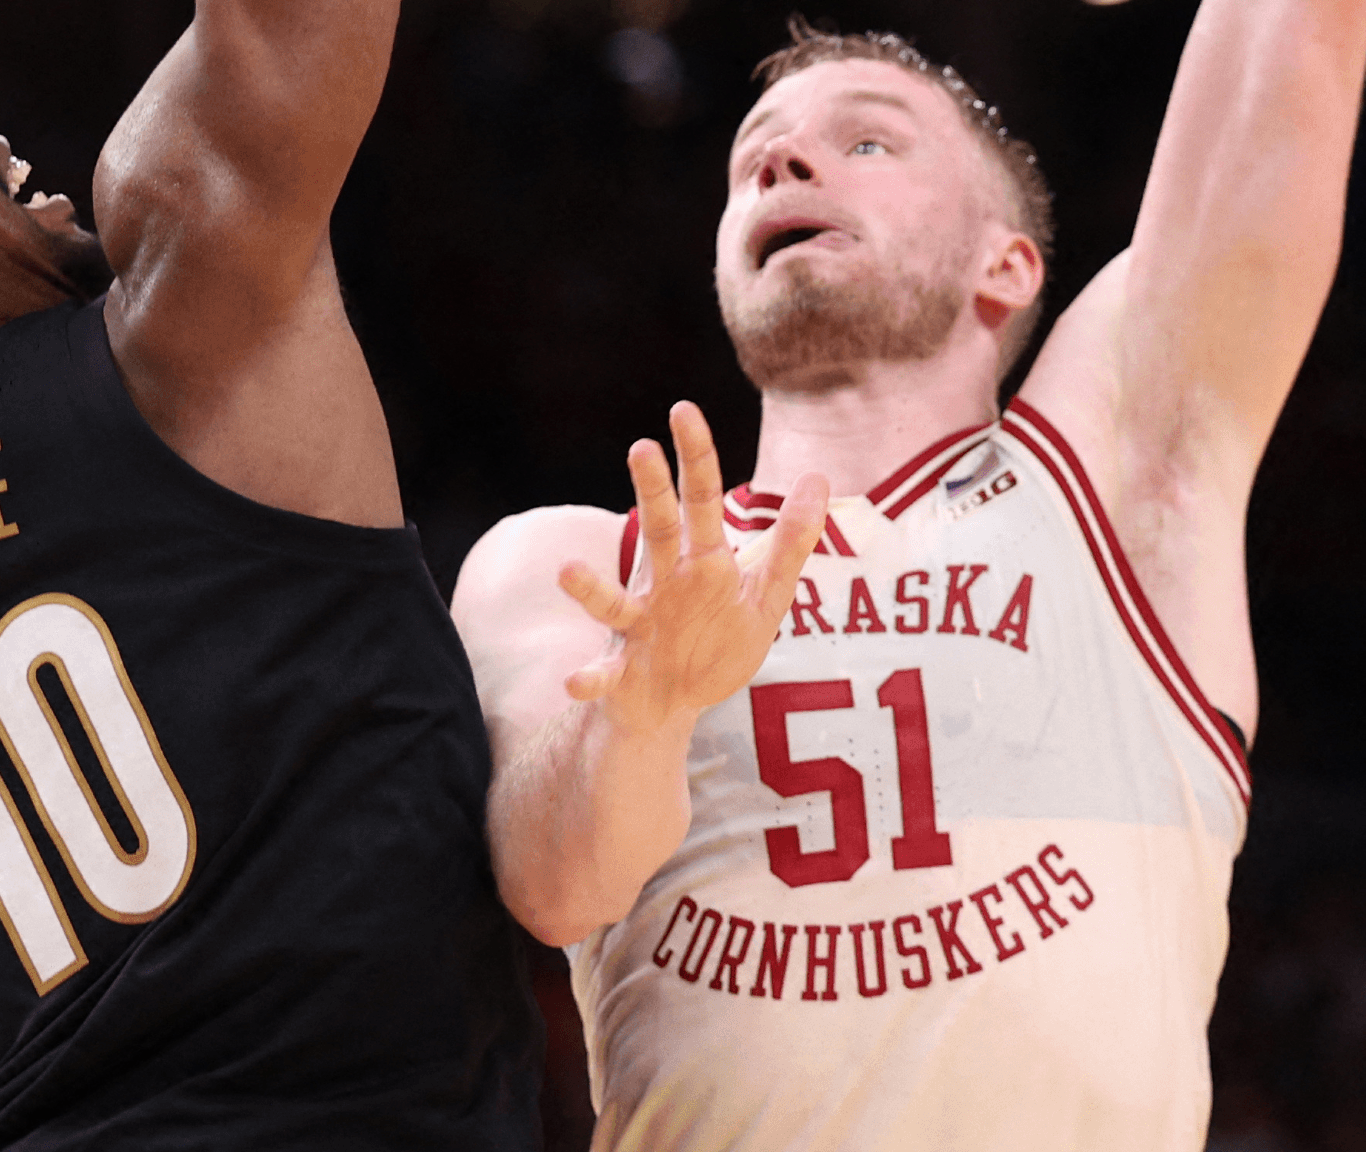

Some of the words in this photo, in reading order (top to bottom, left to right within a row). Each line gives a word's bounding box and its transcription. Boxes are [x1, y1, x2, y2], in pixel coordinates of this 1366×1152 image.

[774, 564, 1035, 652] RASKA
[749, 667, 954, 888] 51
[650, 842, 1096, 1002] CORNHUSKERS
